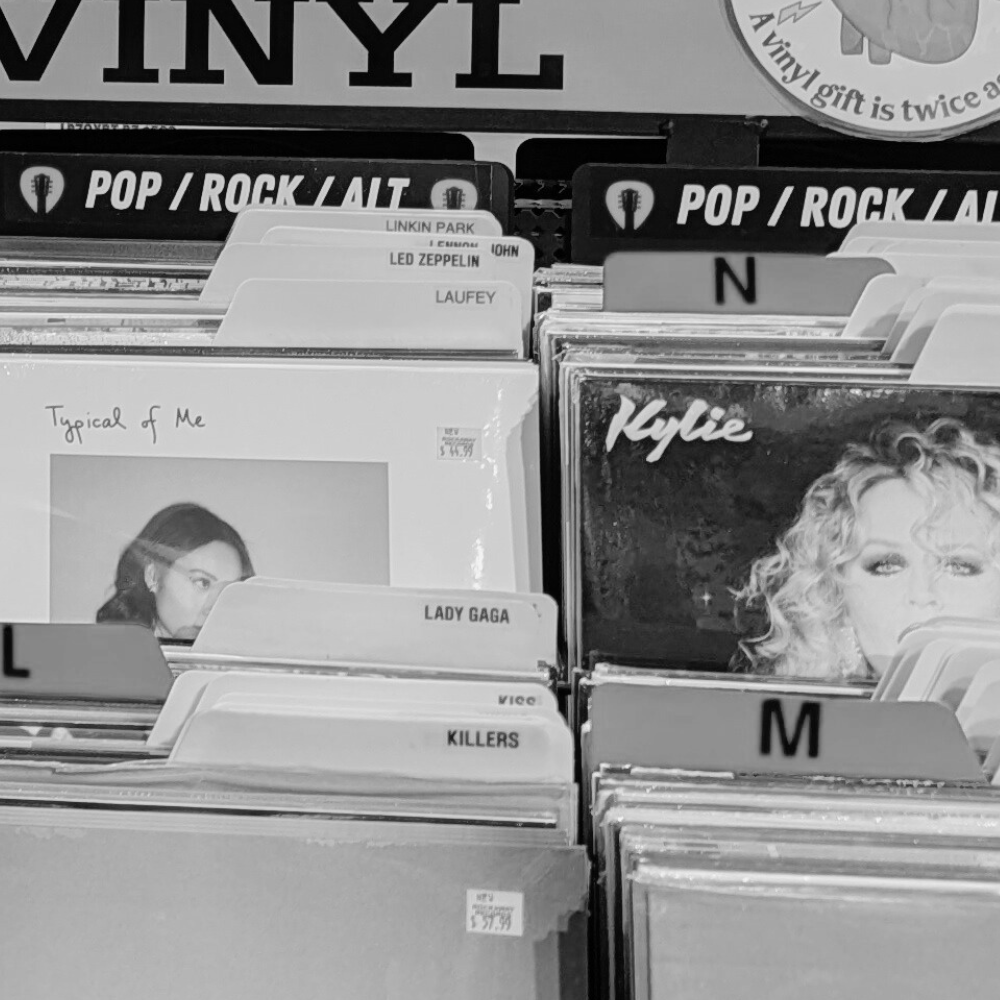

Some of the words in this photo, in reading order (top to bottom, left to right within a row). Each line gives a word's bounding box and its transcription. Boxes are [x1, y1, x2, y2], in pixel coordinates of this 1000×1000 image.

[749, 11, 775, 33] A
[761, 30, 822, 85] vinyl
[809, 81, 866, 111] gift
[871, 95, 896, 122] is
[901, 87, 983, 123] twice
[84, 170, 163, 211] POP
[199, 173, 305, 213] ROCK
[676, 183, 761, 227] POP
[800, 187, 916, 229] ROCK
[386, 220, 431, 233] LINKIN
[434, 222, 476, 235] PARK
[389, 252, 414, 267] LED
[418, 253, 481, 268] ZEPPELIN
[435, 290, 496, 305] LAUFEY
[713, 255, 757, 306] N
[45, 405, 127, 444] Typical
[140, 405, 159, 444] of
[175, 408, 206, 430] Me
[605, 394, 753, 463] Kylie
[424, 604, 463, 623] LADY
[468, 607, 511, 625] GAGA
[2, 623, 30, 679] L
[446, 728, 520, 751] KILLERS
[759, 698, 821, 759] M
